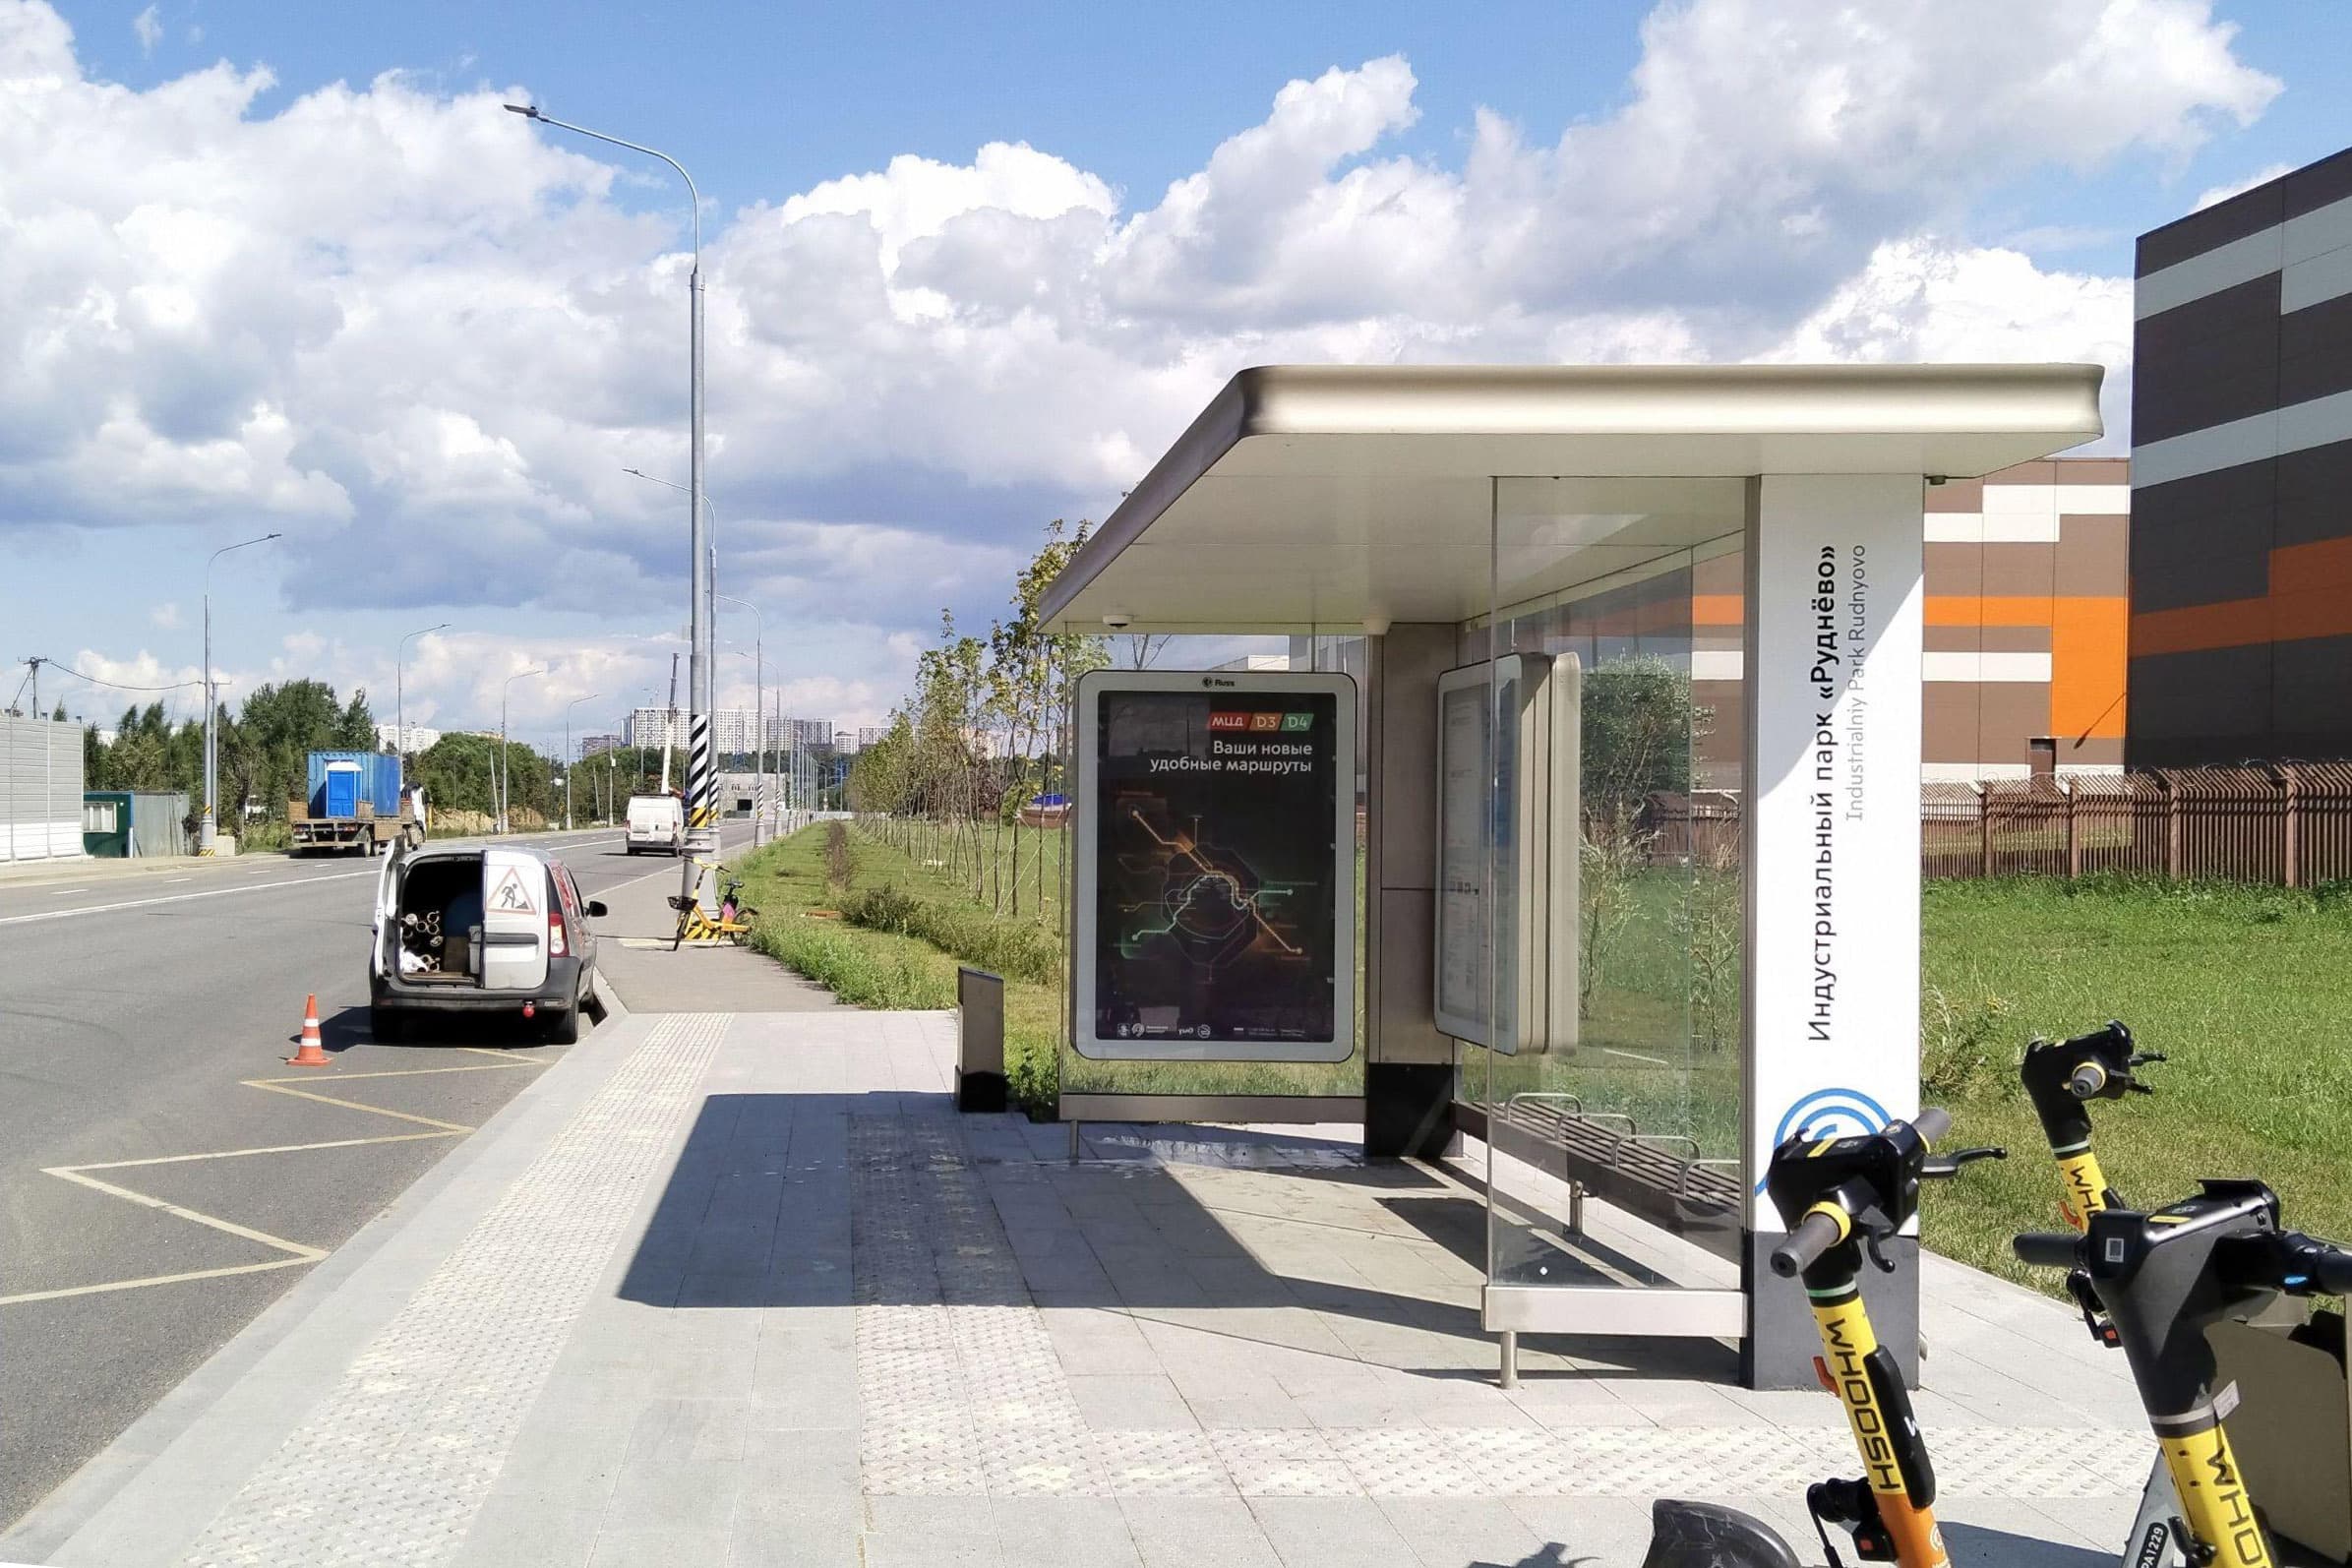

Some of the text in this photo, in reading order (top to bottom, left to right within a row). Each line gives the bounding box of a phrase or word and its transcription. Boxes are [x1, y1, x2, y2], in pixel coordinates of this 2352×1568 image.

[1211, 716, 1307, 728] МЦД D3 D4
[1845, 545, 1869, 821] Industrialniy Park Rudnyovo
[1150, 756, 1312, 775] удобные маршруты
[1213, 740, 1313, 755] Ваши новые
[1808, 545, 1839, 1041] Индустриальный парк «Руднёво»
[2070, 1166, 2101, 1220] WH
[1826, 1318, 1901, 1490] WHOOSH
[2206, 1446, 2270, 1568] WHO
